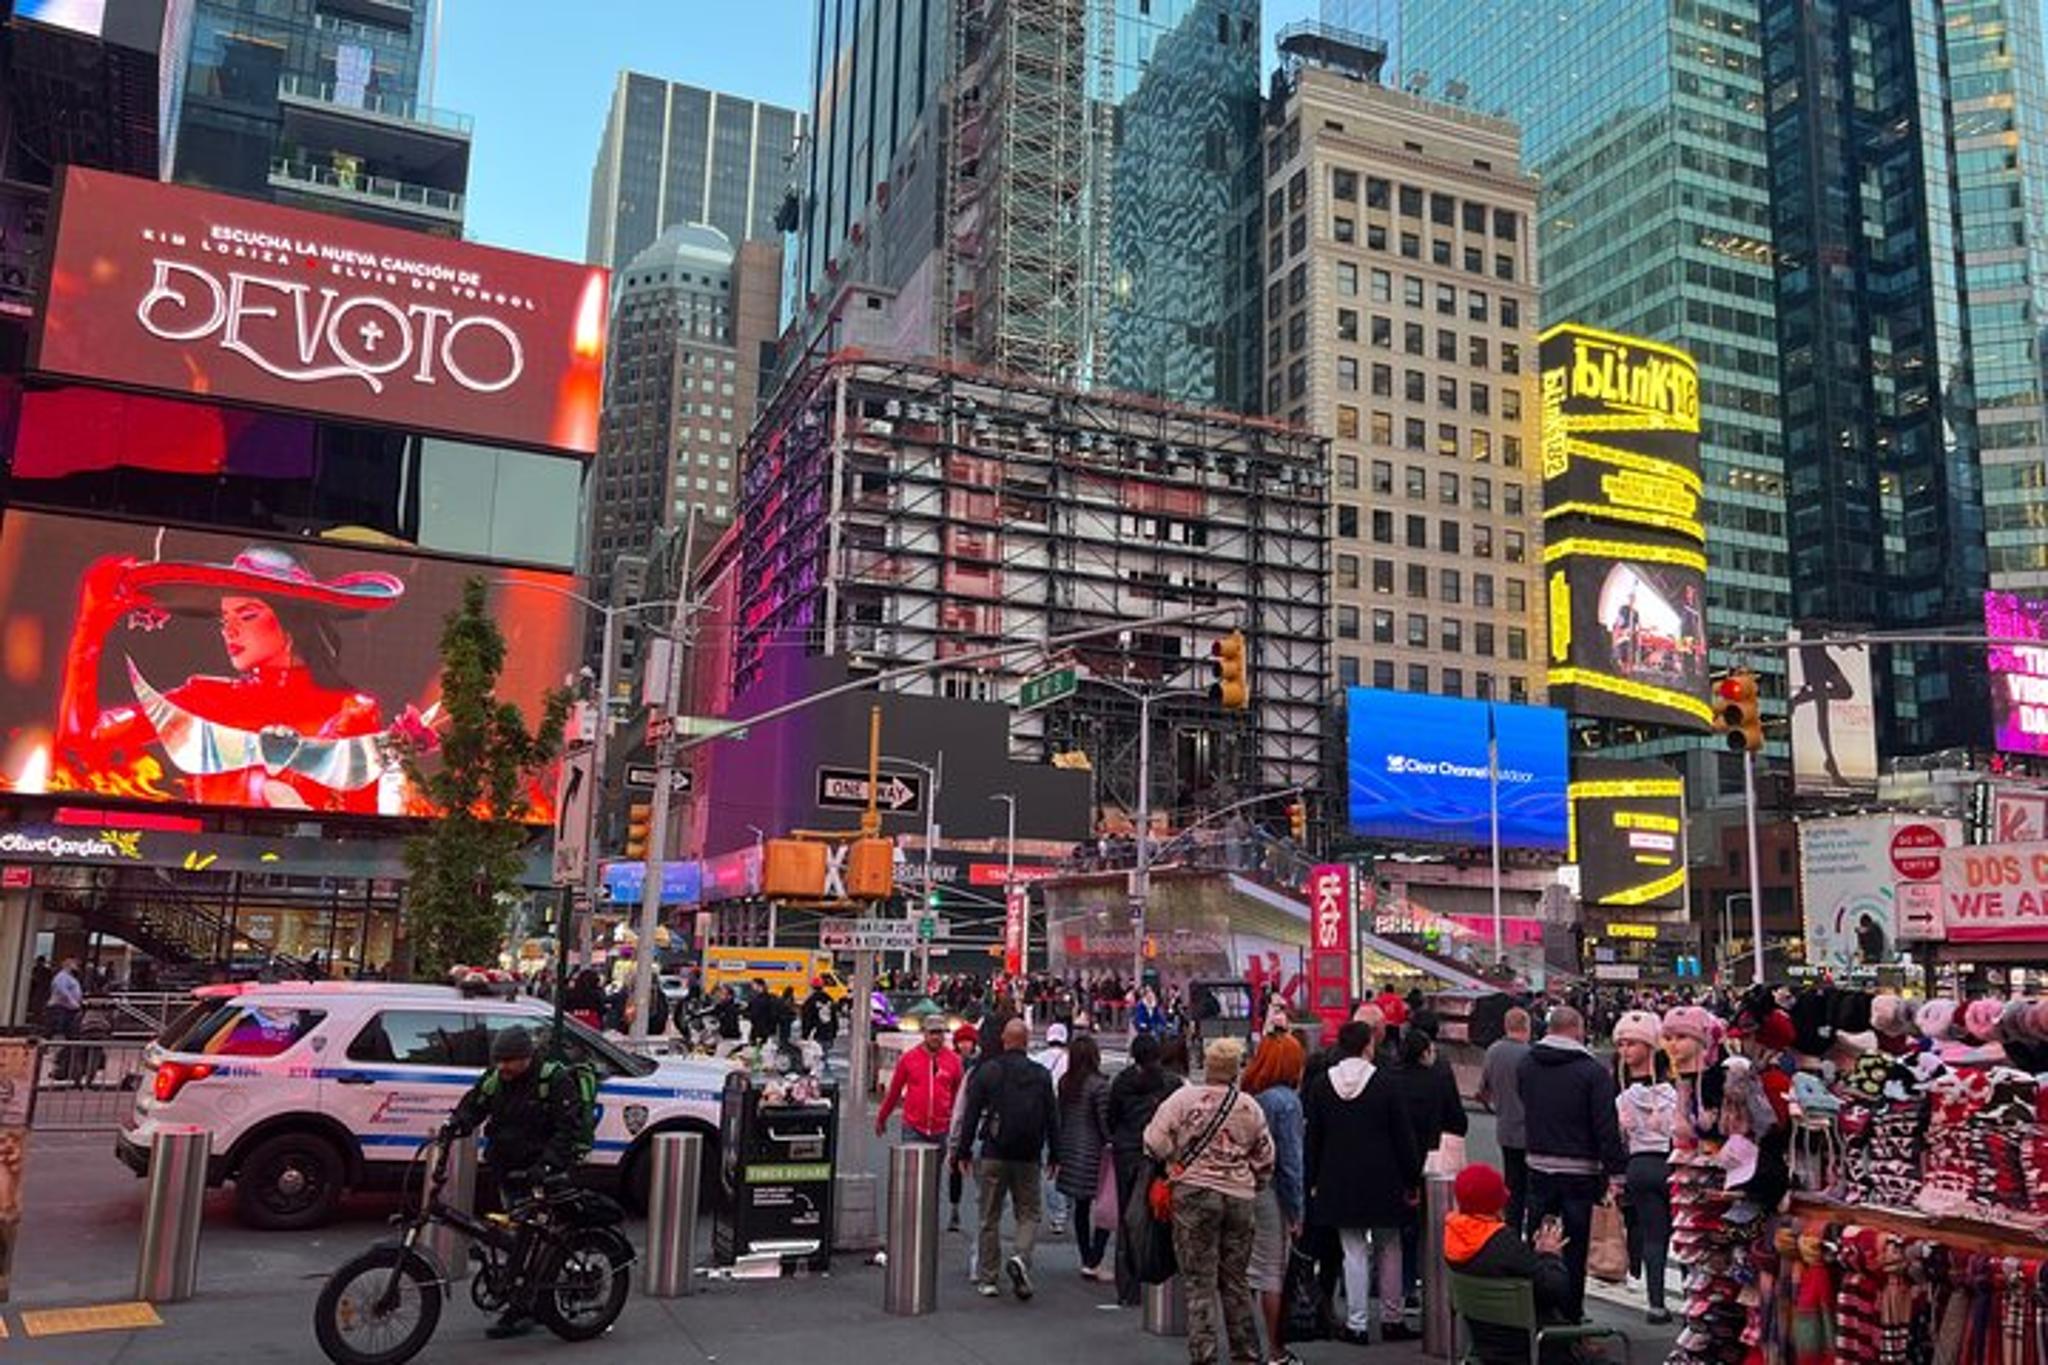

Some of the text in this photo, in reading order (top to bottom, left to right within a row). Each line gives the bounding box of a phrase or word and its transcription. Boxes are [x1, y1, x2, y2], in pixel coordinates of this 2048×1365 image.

[142, 229, 186, 246] KIM
[202, 240, 289, 266] LOAIZA
[412, 278, 436, 292] DE
[211, 225, 481, 287] ESCUCHA LA NUEVA CANCIÓN DE
[136, 259, 523, 394] DEVOTO
[1404, 758, 1534, 783] Clear Channel utdoor
[832, 780, 905, 803] ONE WAY
[0, 833, 117, 857] Olive Garden
[1899, 833, 1936, 847] DO NOT
[893, 863, 957, 882] BROAWAY
[1902, 859, 1936, 872] ENTER
[1966, 855, 2021, 888] DOS
[1319, 872, 1342, 948] tkts
[1951, 892, 2004, 918] WE
